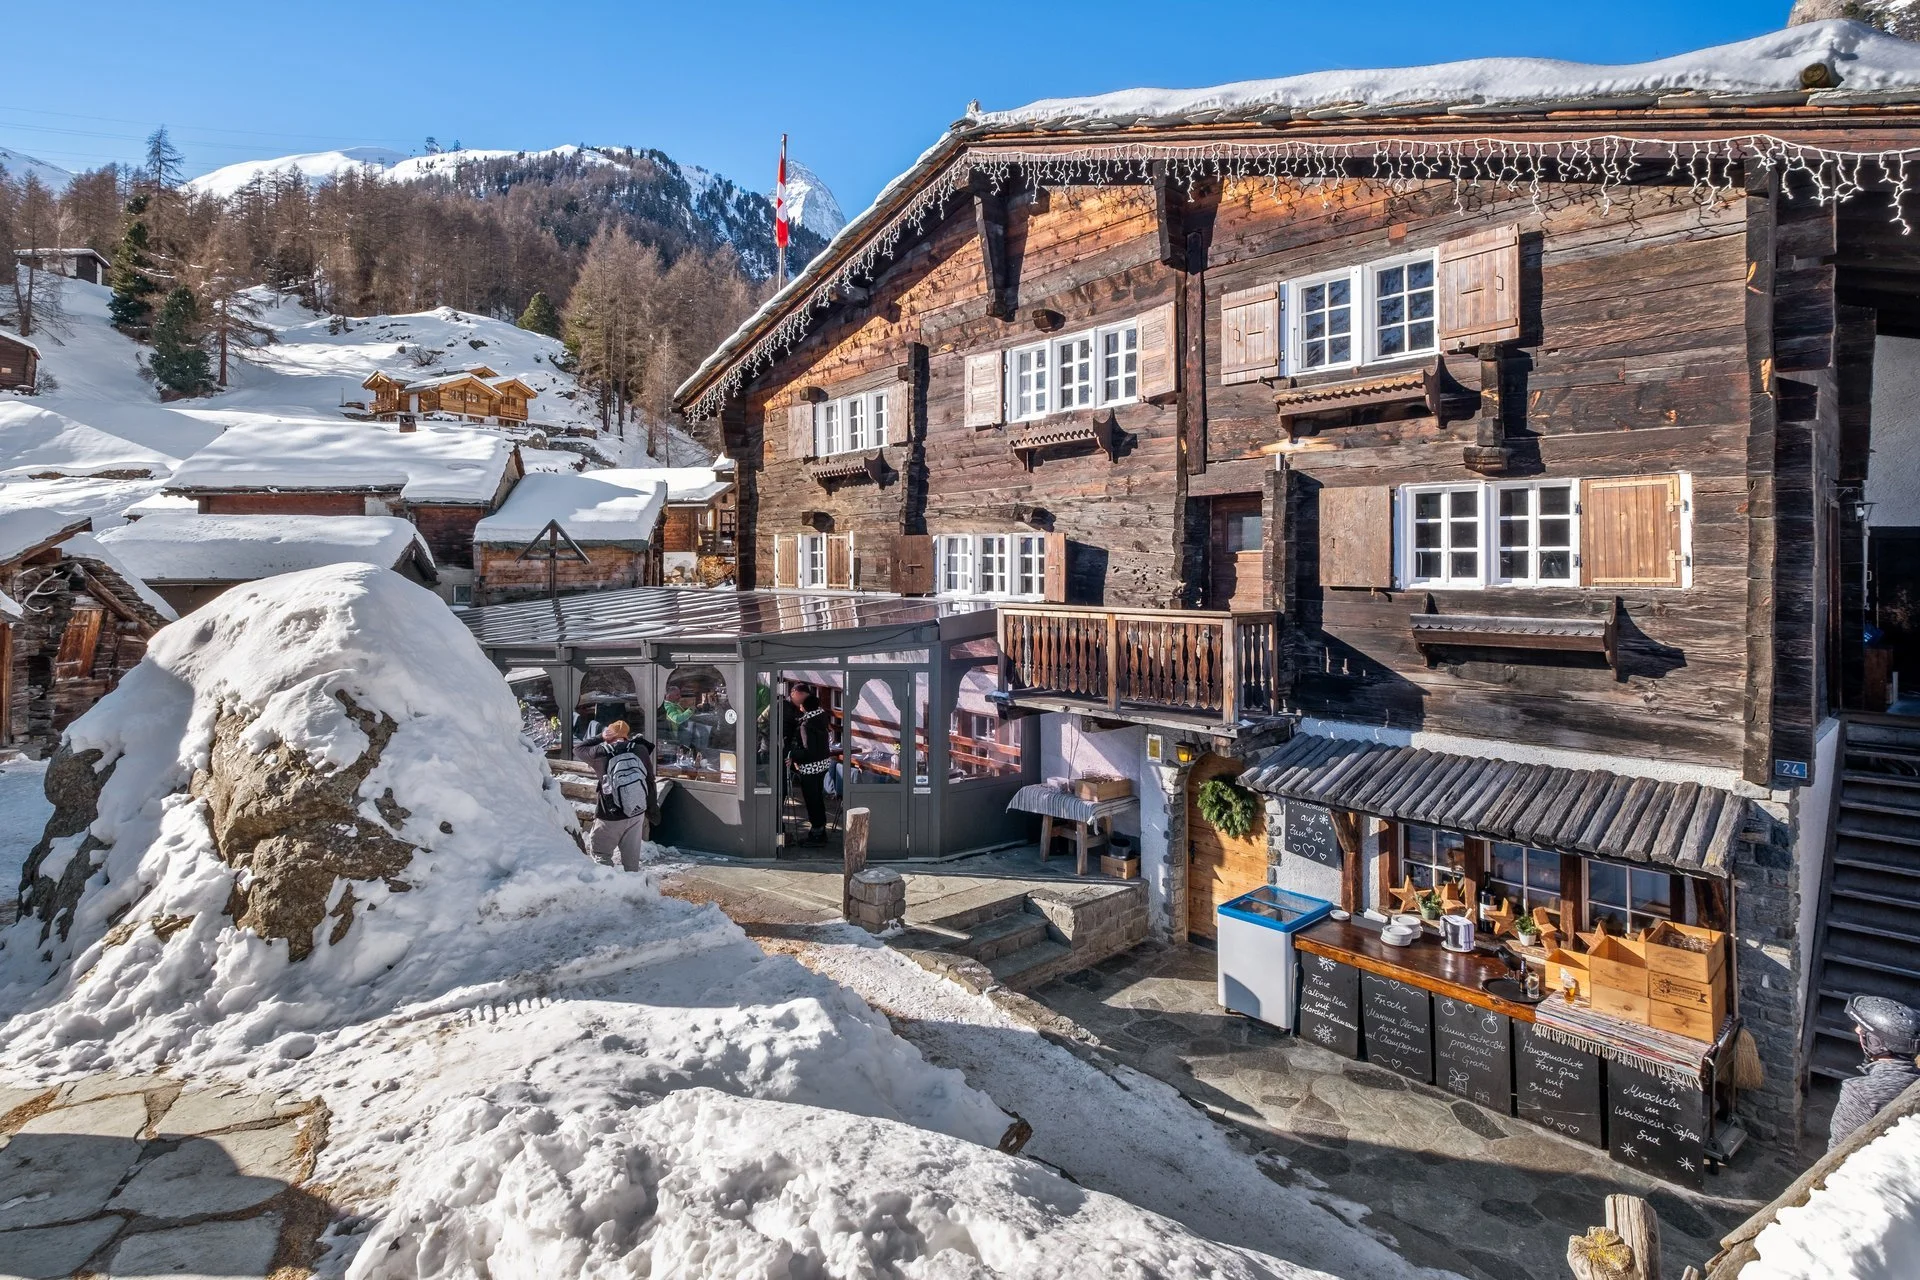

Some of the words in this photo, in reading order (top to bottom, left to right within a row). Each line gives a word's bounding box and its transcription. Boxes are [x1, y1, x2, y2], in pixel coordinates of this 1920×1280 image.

[1782, 763, 1799, 776] 24
[1301, 814, 1316, 826] auf
[1312, 831, 1326, 845] See
[1312, 974, 1331, 988] Feine
[1374, 993, 1408, 1014] Frische
[1559, 1067, 1580, 1080] Gras
[1545, 1078, 1564, 1089] mit
[1623, 1084, 1682, 1111] Muscheln
[1645, 1103, 1660, 1115] im
[1637, 1130, 1661, 1146] Sud
